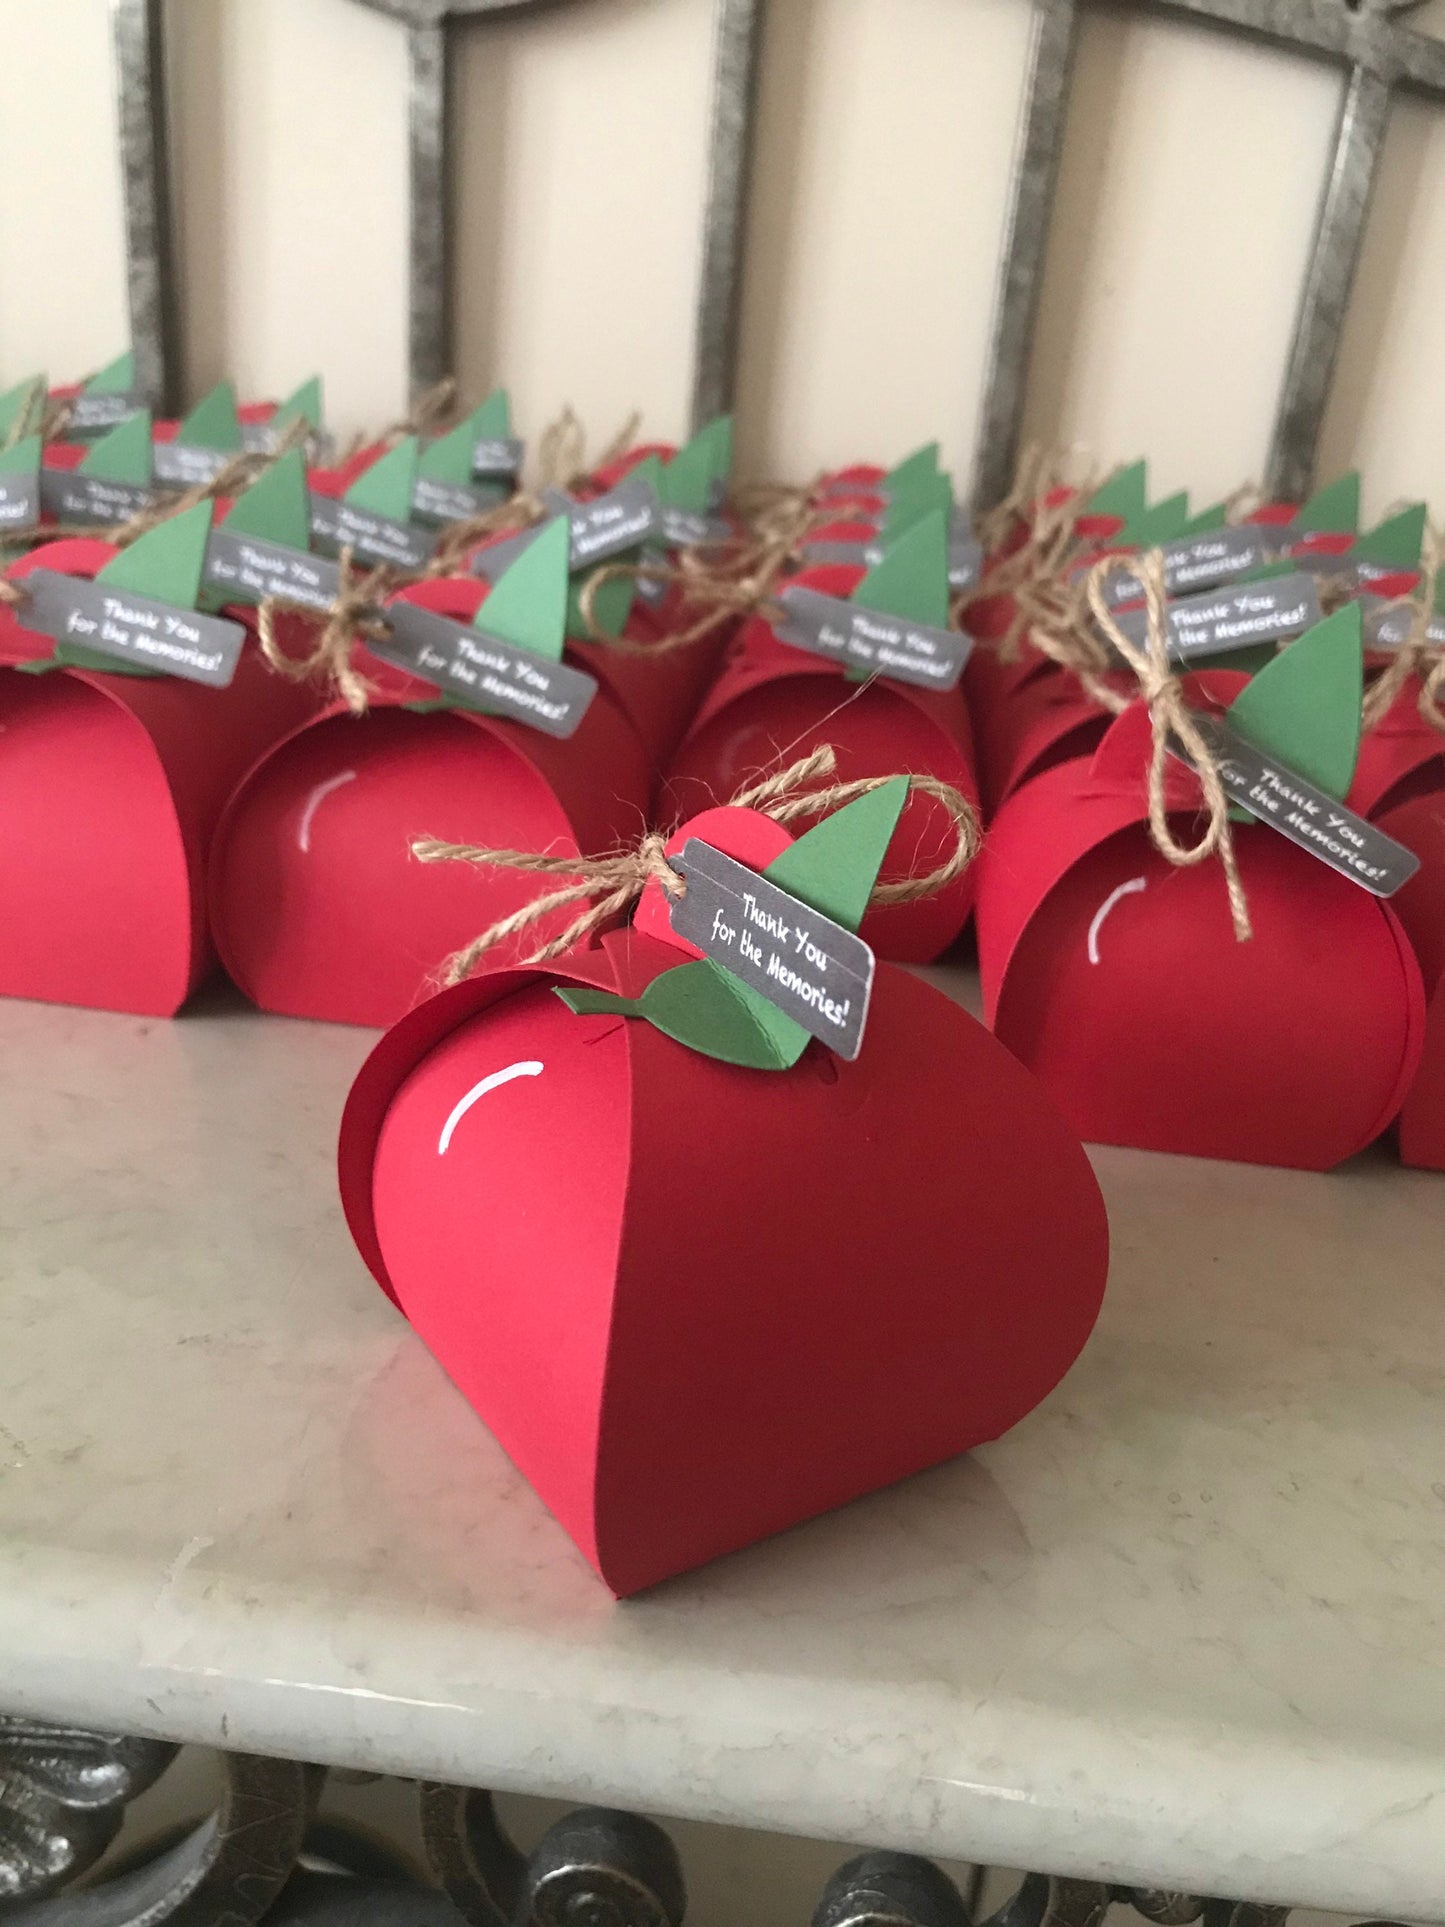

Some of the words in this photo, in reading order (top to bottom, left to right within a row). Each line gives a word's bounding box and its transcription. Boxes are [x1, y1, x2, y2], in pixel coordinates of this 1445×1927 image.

[66, 608, 98, 635] for
[101, 619, 130, 646] the
[134, 632, 223, 671] Memories!
[103, 597, 160, 630] Thank
[165, 615, 201, 643] You
[1170, 604, 1230, 628] Thank
[1234, 594, 1276, 616] You
[1214, 602, 1308, 640] Memories!
[458, 637, 511, 673] Thank
[515, 660, 550, 691] You
[480, 675, 570, 720] Memories!
[1249, 784, 1280, 813] the
[1284, 811, 1388, 881] Memories!
[1260, 768, 1322, 816] Thank
[1326, 812, 1365, 848] You
[743, 892, 790, 943] Thank
[795, 927, 828, 971] You
[710, 908, 736, 945] for
[739, 928, 762, 967] the
[766, 952, 850, 1028] Memories!
